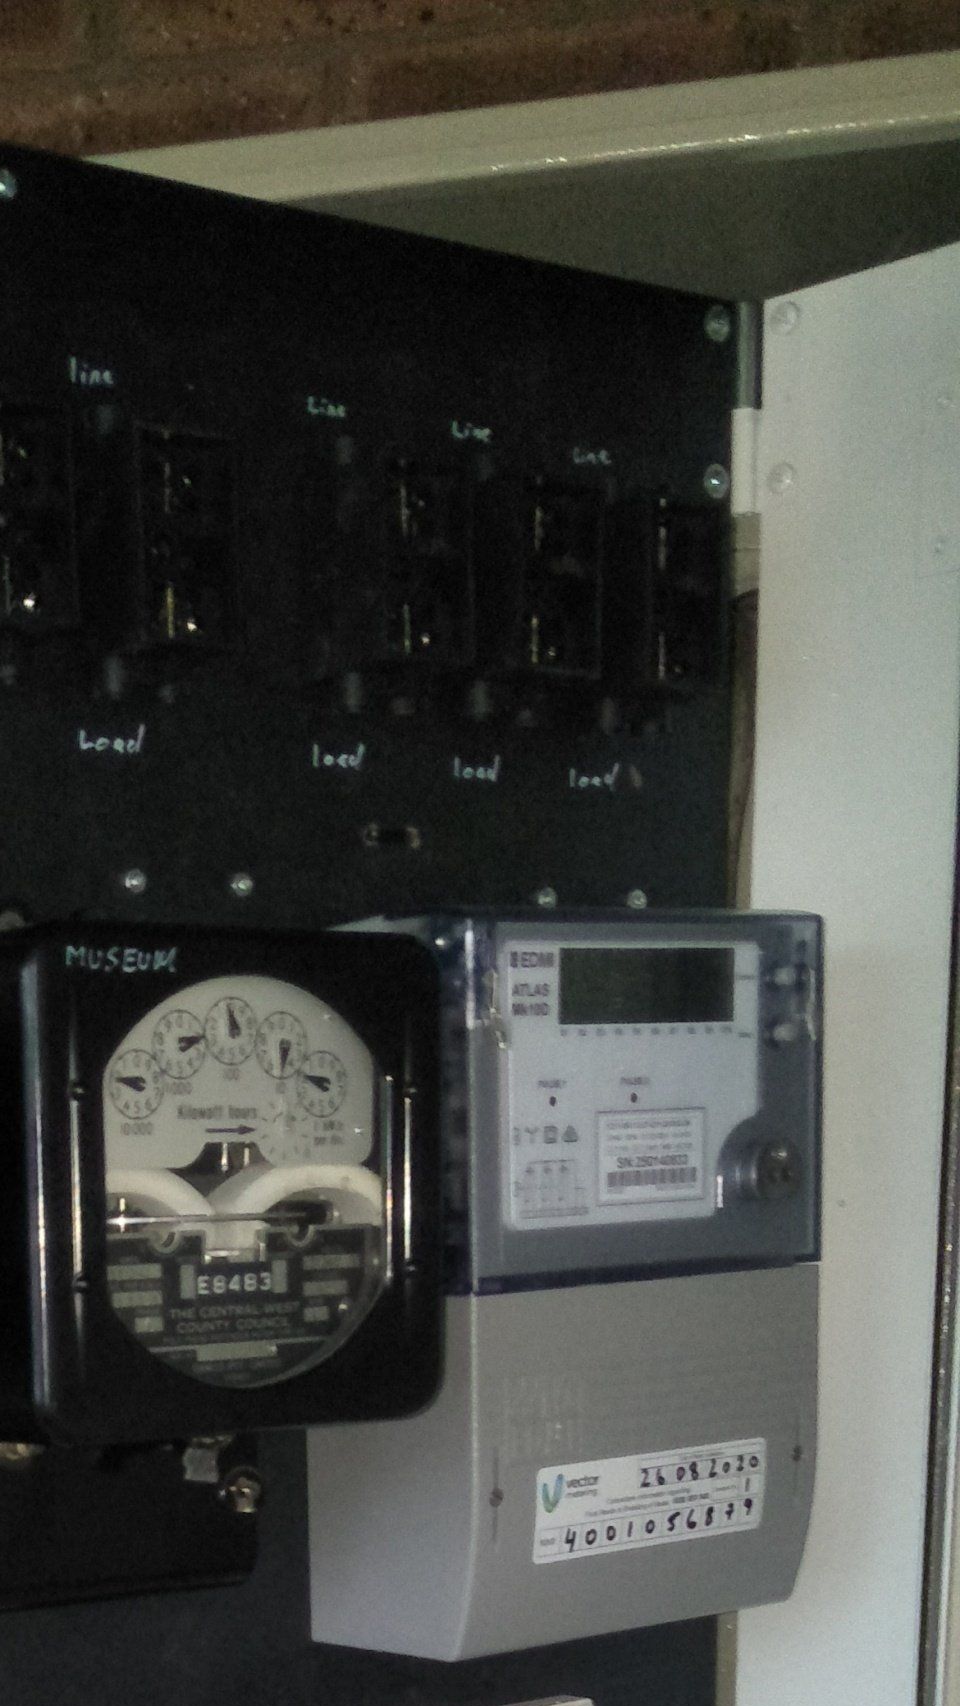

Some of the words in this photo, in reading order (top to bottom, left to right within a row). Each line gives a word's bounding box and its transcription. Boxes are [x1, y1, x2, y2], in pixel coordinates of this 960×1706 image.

[78, 723, 146, 754] Load
[453, 755, 501, 783] load
[65, 945, 178, 973] MUSEUM
[675, 1462, 699, 1482] 08
[708, 1454, 760, 1479] 2020
